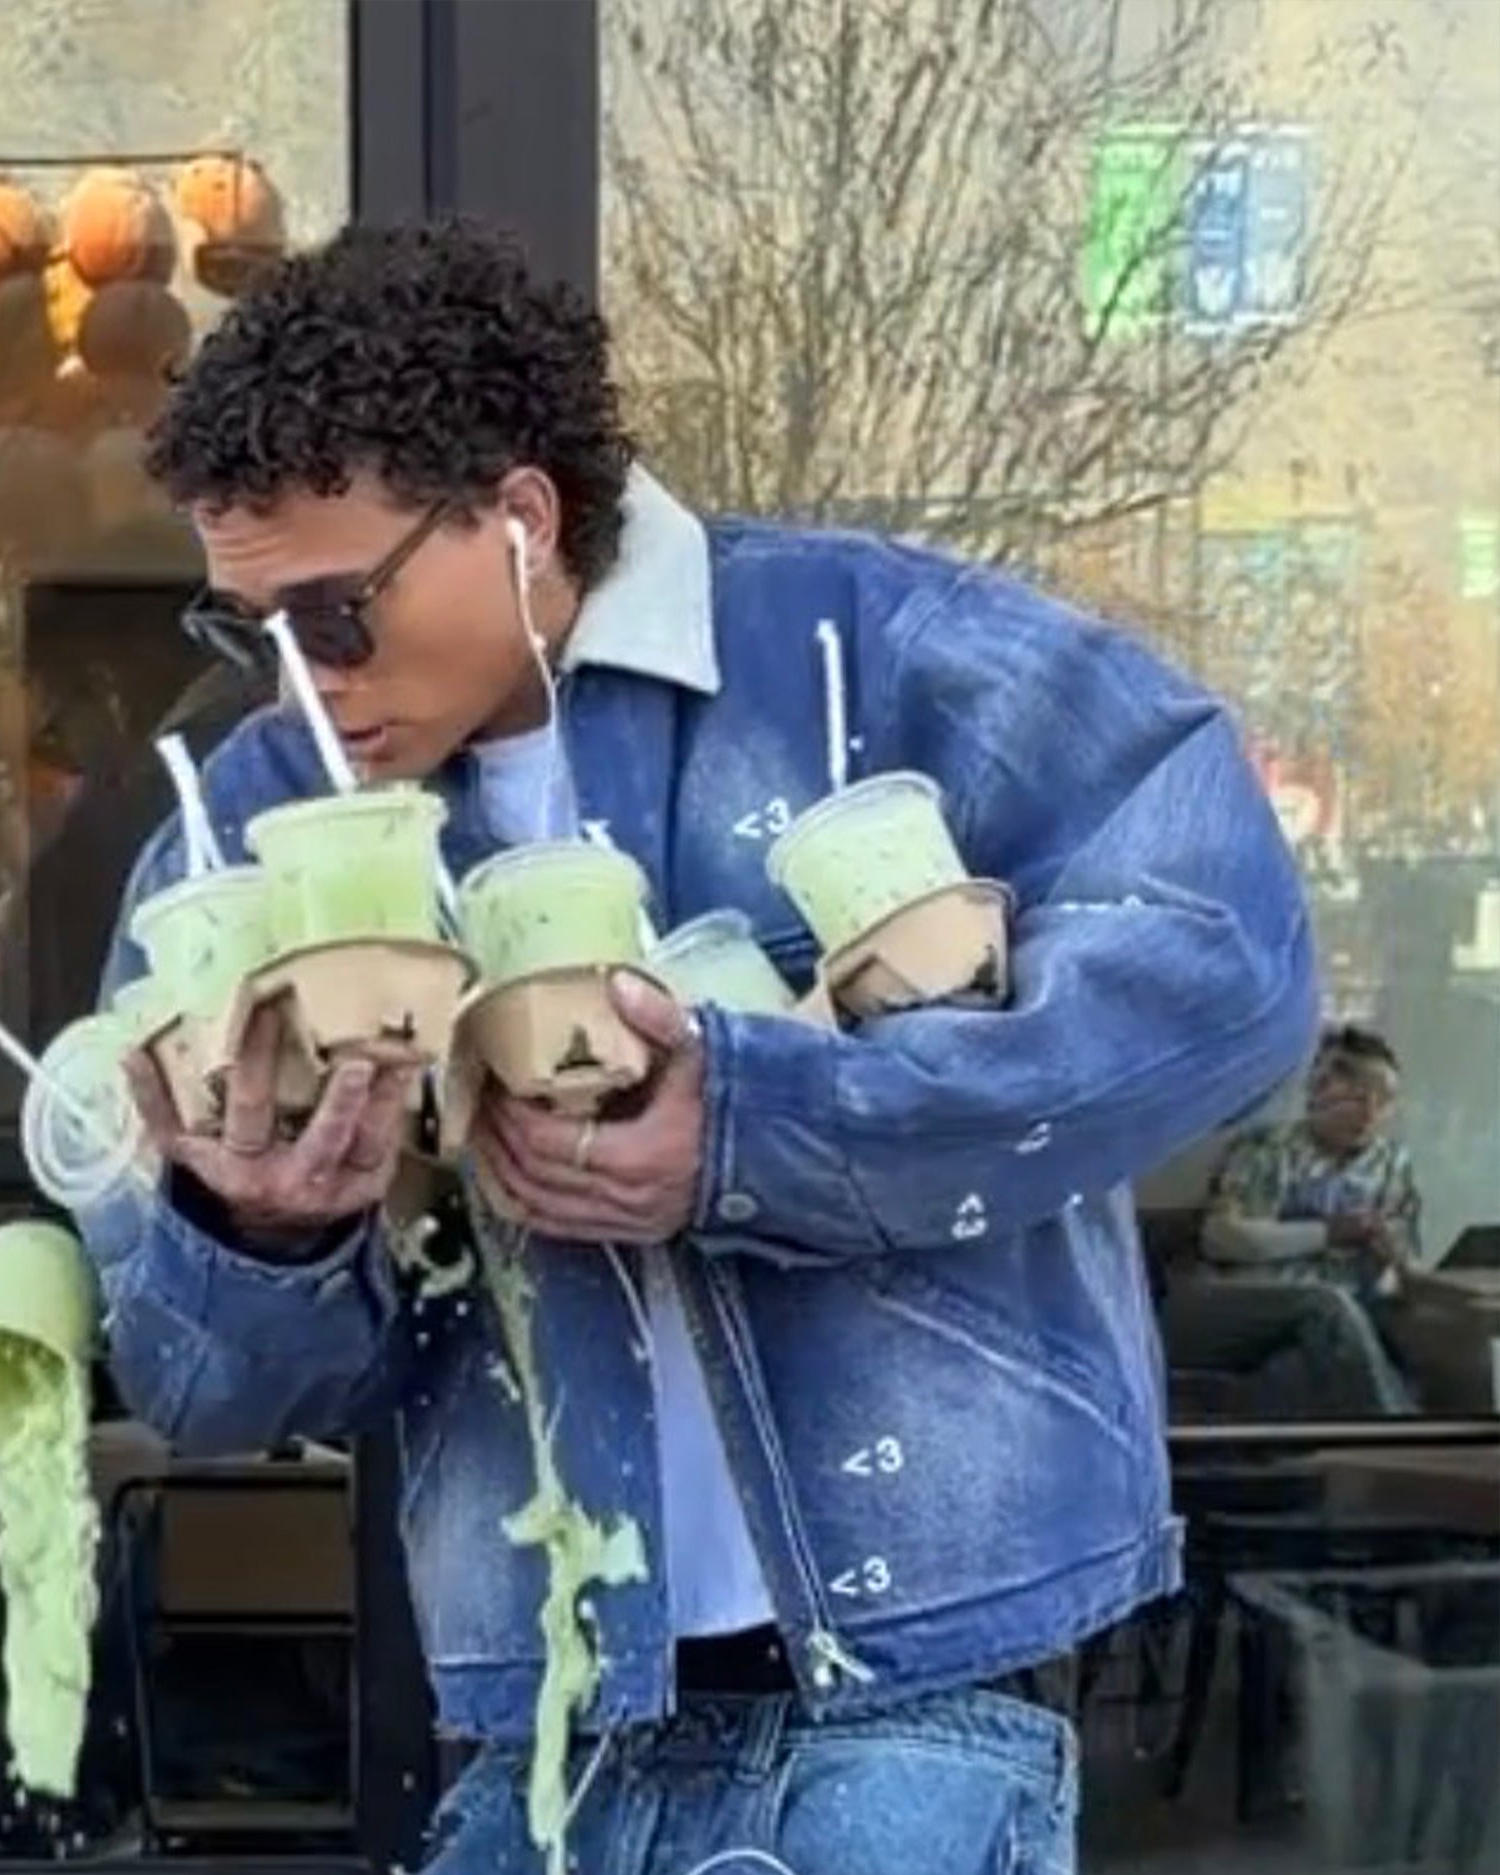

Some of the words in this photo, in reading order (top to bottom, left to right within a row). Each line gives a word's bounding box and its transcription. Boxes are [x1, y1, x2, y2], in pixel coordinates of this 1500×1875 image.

[733, 798, 788, 838] <3
[842, 1436, 903, 1476] <3
[829, 1556, 892, 1596] <3
